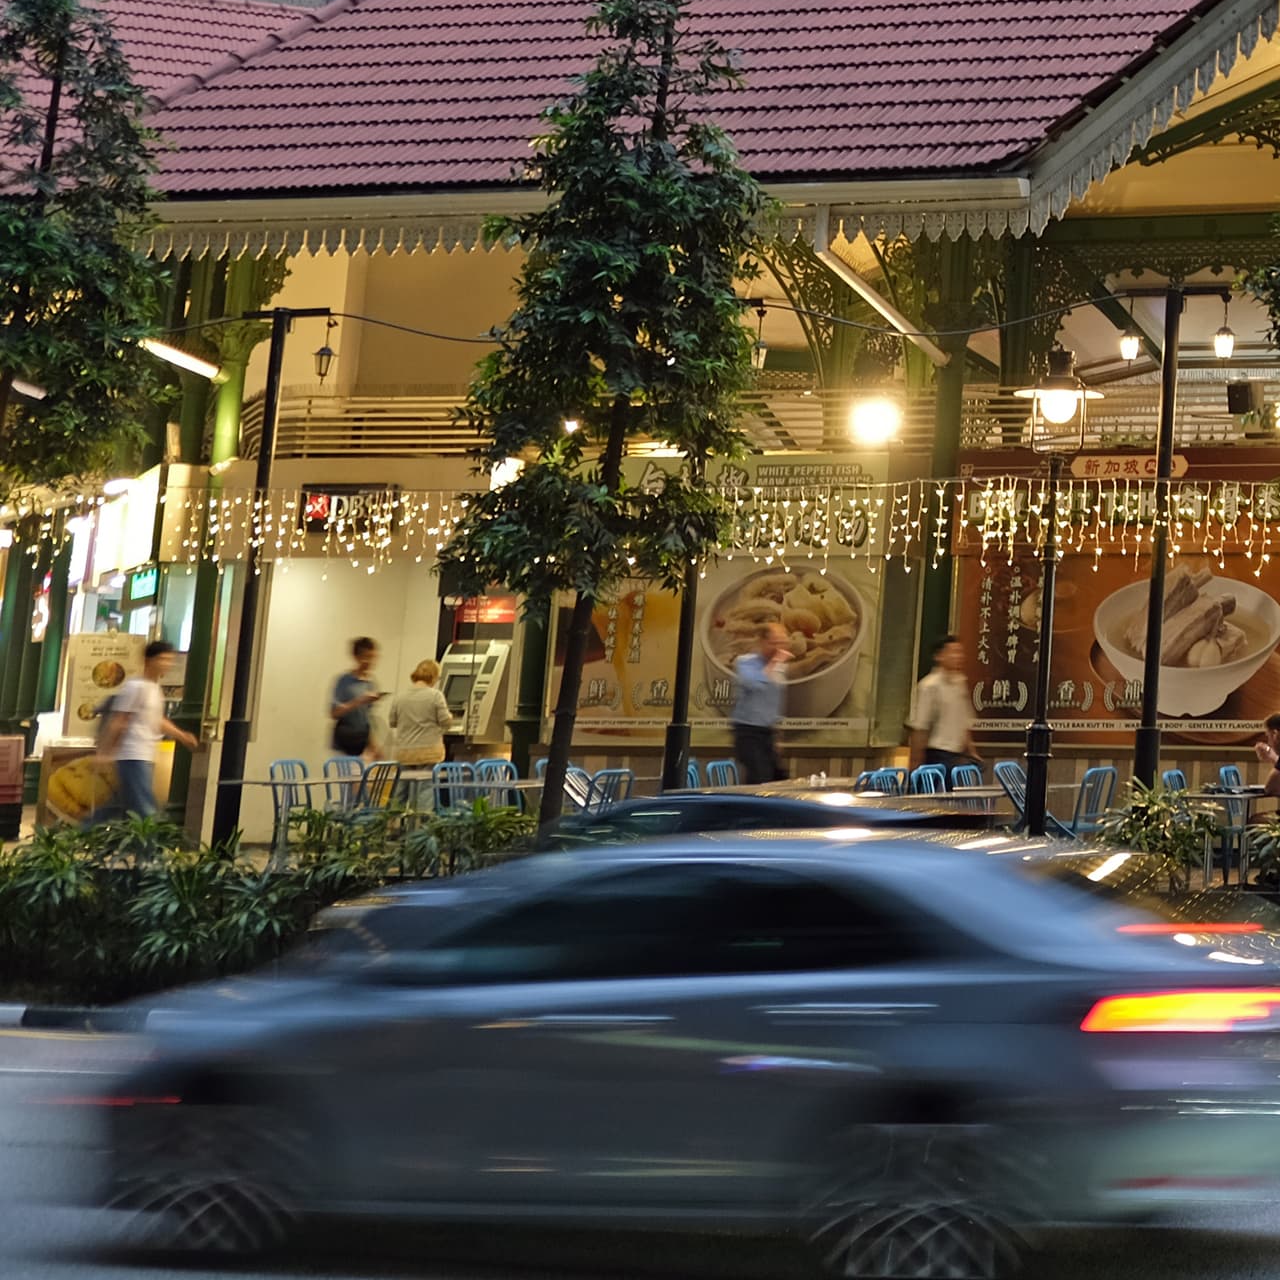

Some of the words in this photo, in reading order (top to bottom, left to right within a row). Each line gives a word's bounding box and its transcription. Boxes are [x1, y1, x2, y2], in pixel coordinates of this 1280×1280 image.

[758, 465, 791, 476] WHITE
[793, 465, 833, 475] PEPPER
[835, 465, 859, 475] FISH
[1084, 460, 1140, 475] 新加坡
[755, 488, 801, 499] HICKEN
